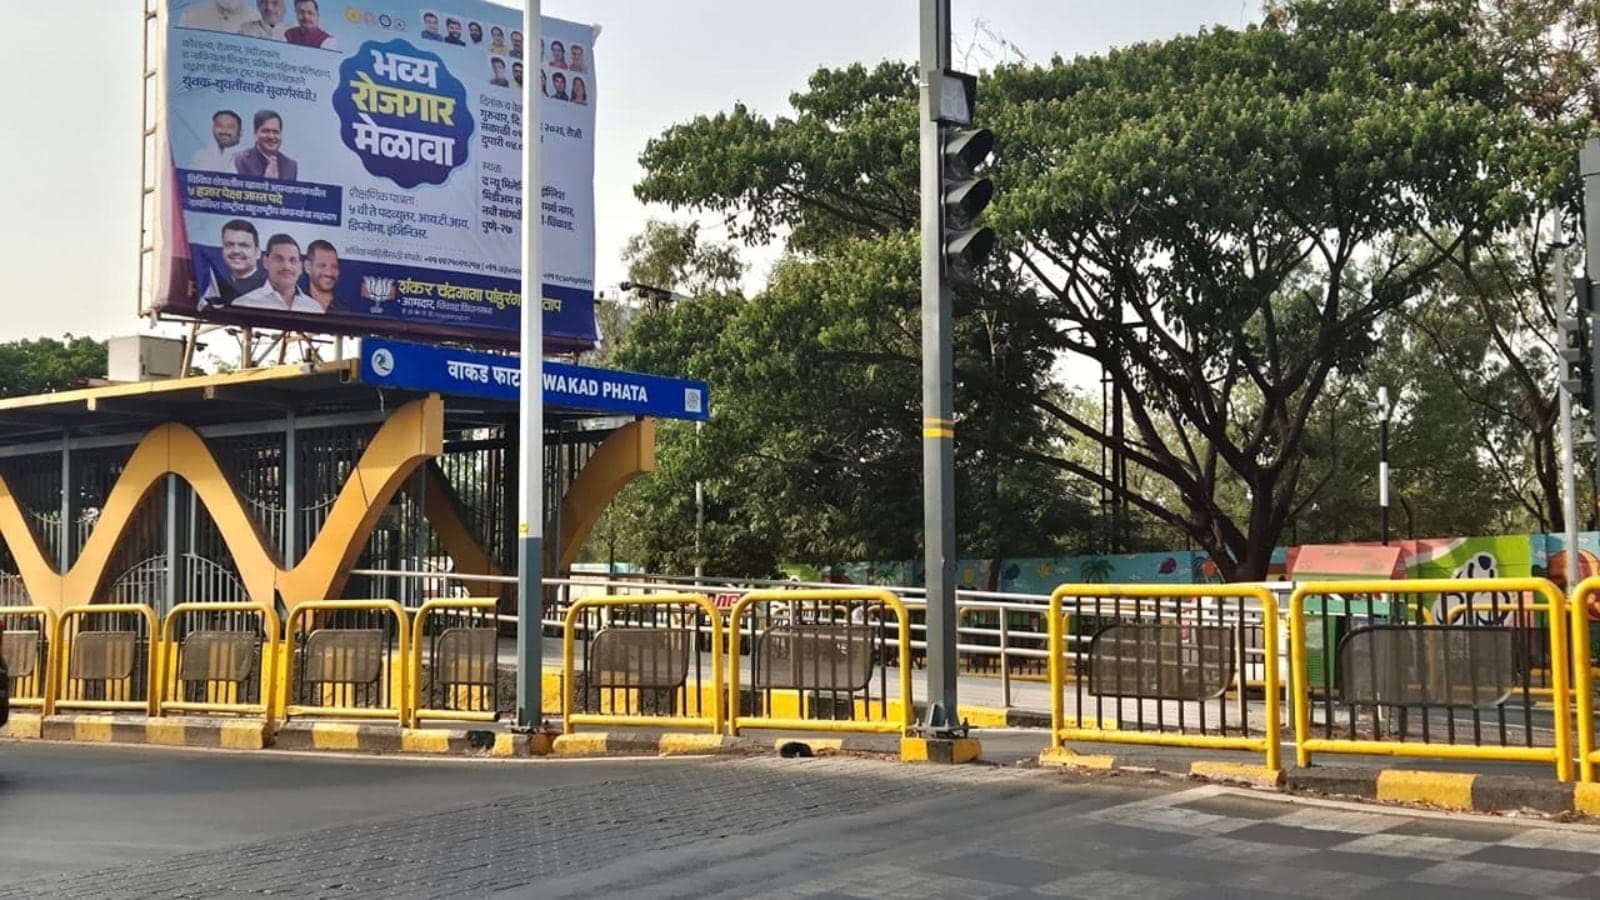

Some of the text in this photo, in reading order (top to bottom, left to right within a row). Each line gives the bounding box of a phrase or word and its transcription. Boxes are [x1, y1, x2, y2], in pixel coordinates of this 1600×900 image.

[370, 49, 439, 89] भव्य
[349, 70, 457, 126] रोजगार
[352, 112, 456, 166] मेळावा
[397, 277, 436, 296] शंकर
[436, 281, 484, 302] चंद्रभागा
[446, 359, 521, 388] वाकड फाट
[543, 372, 648, 403] WAKAD PHATA
